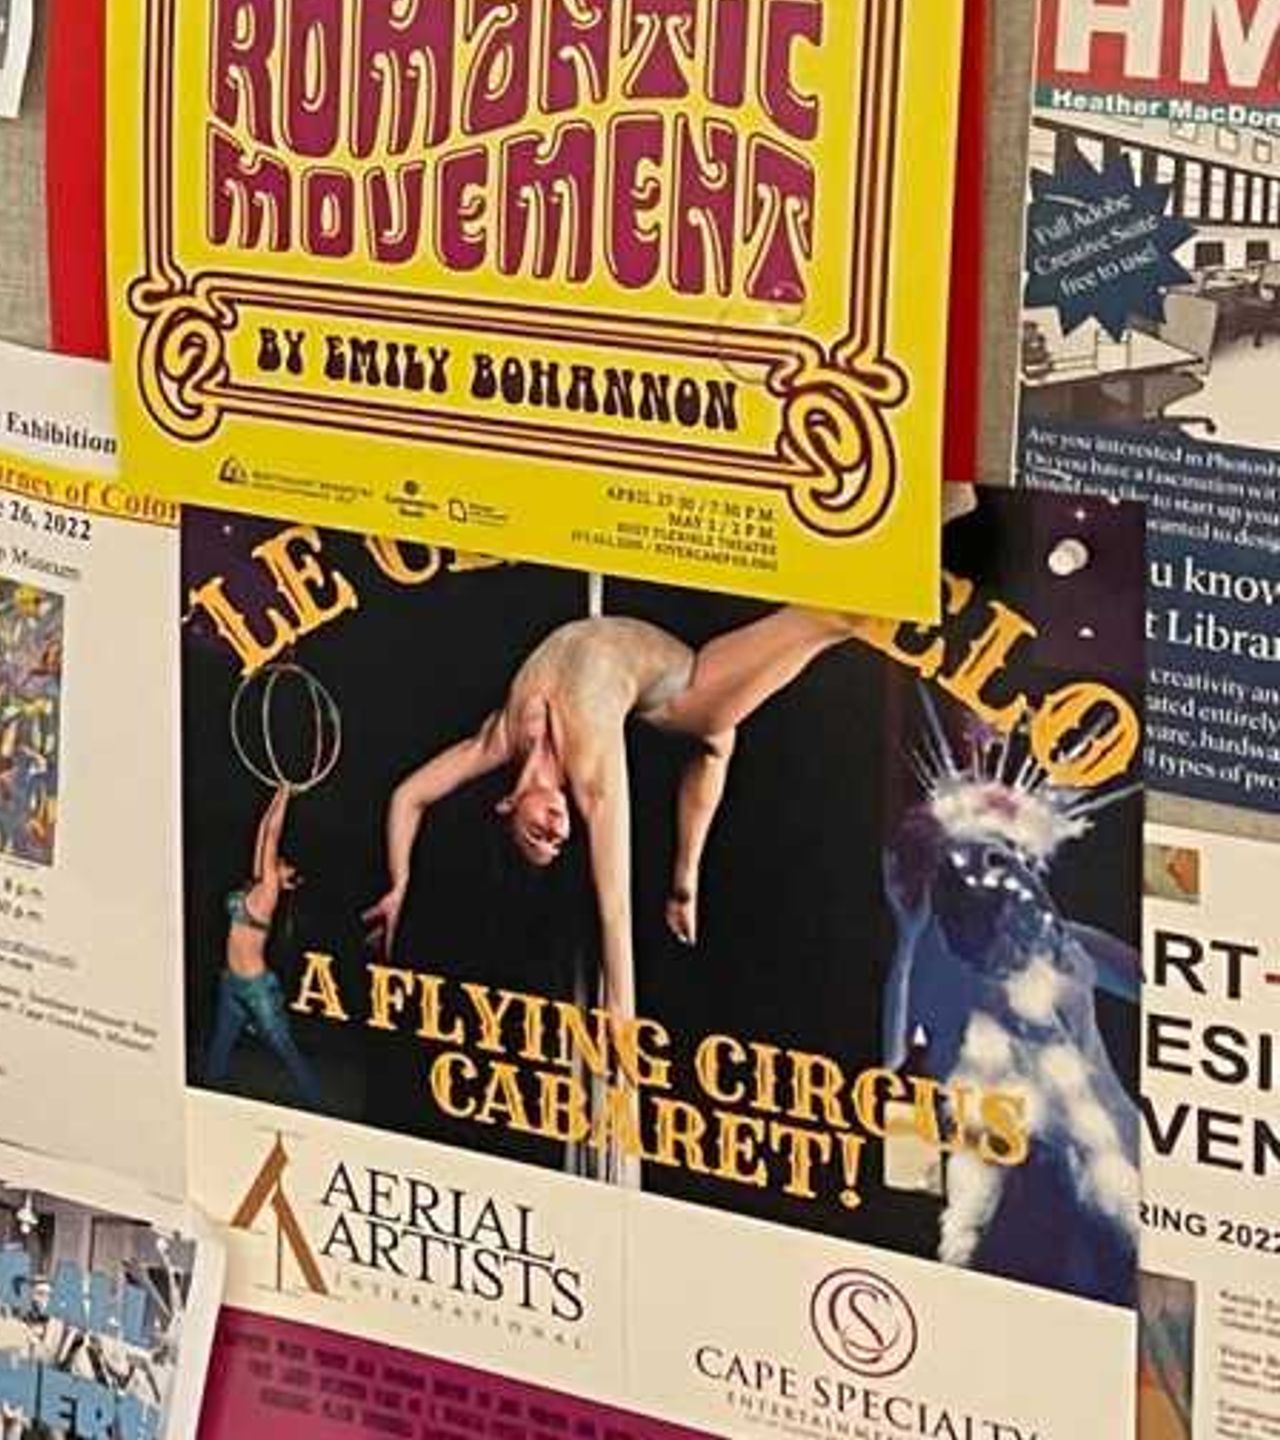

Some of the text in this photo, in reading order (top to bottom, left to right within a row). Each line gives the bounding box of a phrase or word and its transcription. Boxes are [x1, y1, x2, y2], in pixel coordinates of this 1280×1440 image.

[1052, 89, 1166, 117] Heather
[206, 111, 819, 305] MOVEMENT
[1073, 190, 1133, 229] Adobe
[1033, 230, 1110, 276] Creative
[1099, 258, 1119, 281] to
[256, 325, 739, 433] BY EMILY BOHANNON
[6, 409, 119, 456] Exhibition
[65, 472, 94, 503] of
[8, 502, 39, 530] 26,
[43, 511, 92, 542] 2022
[188, 524, 360, 677] LE
[289, 951, 348, 1020] A
[364, 960, 673, 1090] FLYING
[694, 1032, 1034, 1169] CIRCUS
[428, 1050, 869, 1213] CABARET!
[320, 1160, 557, 1264] AERIAL
[320, 1212, 584, 1324] ARTISTS
[695, 1345, 798, 1399] CAPE
